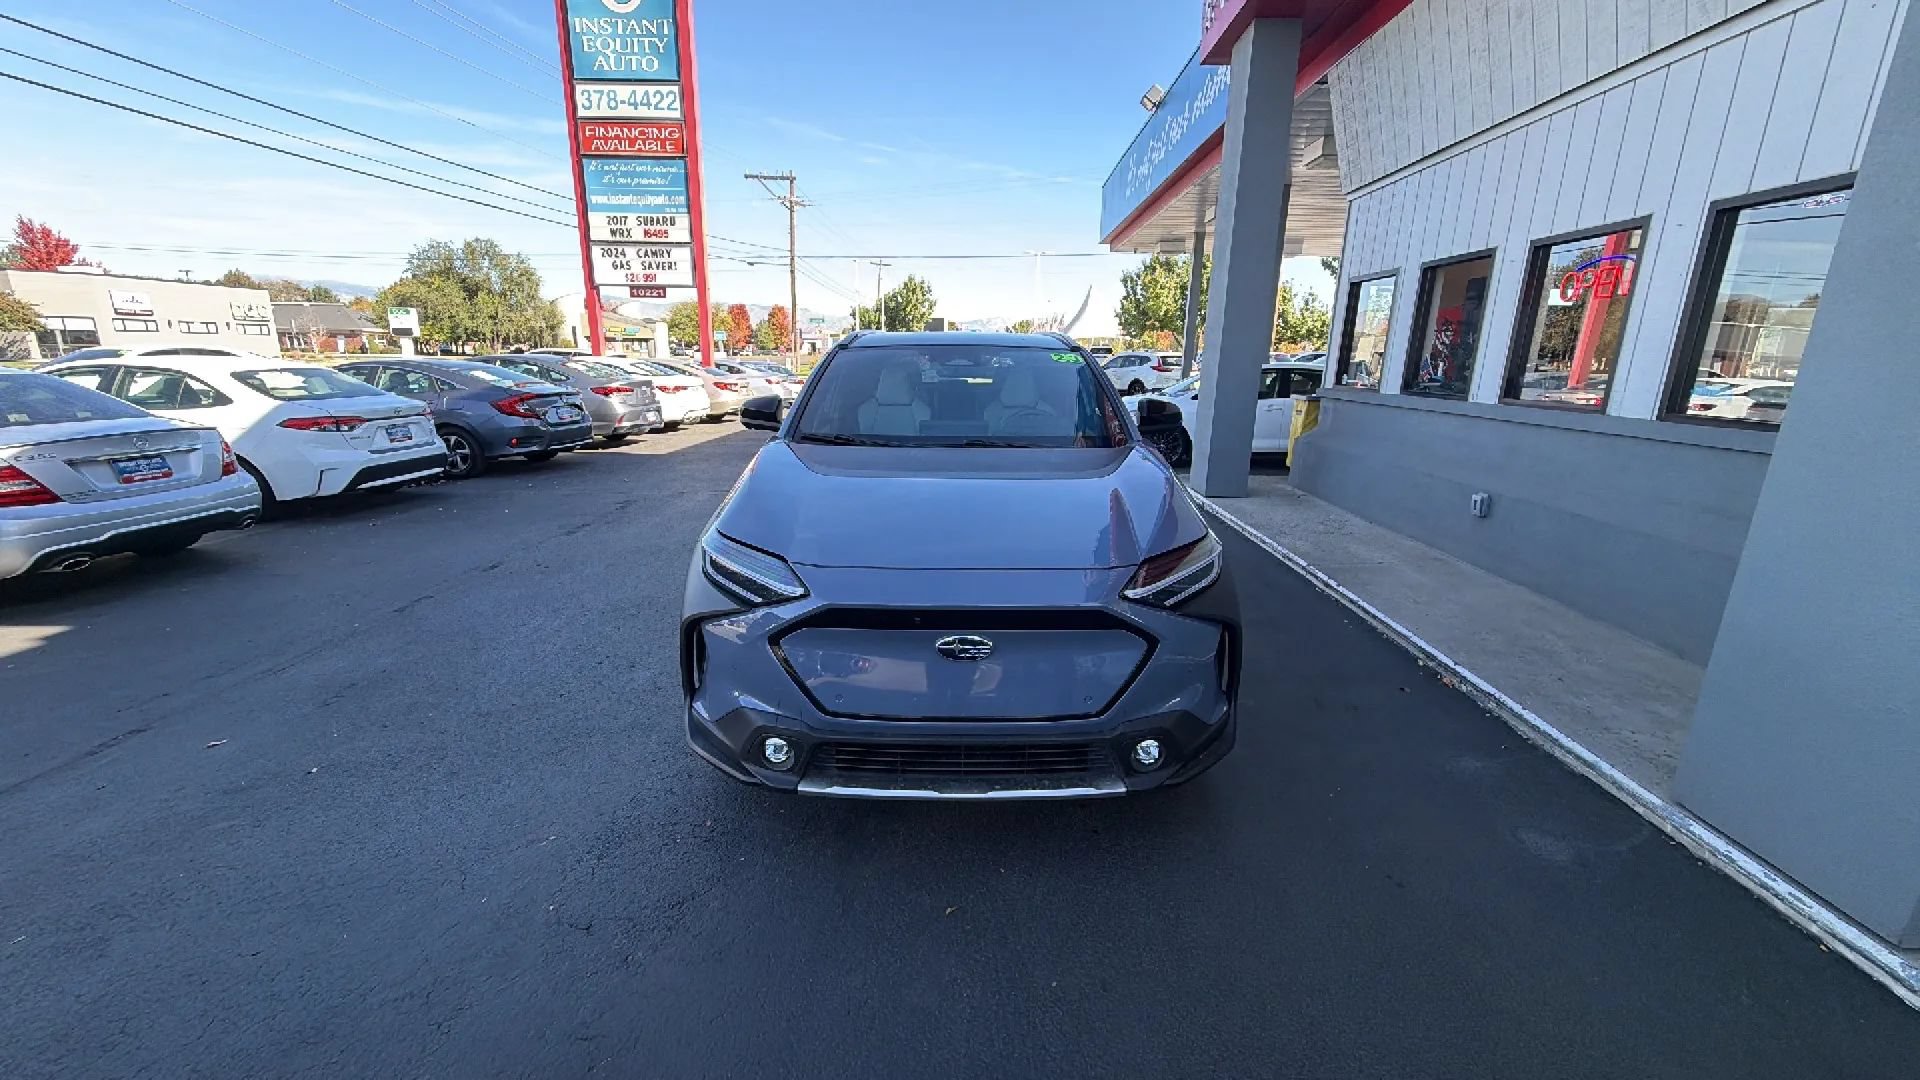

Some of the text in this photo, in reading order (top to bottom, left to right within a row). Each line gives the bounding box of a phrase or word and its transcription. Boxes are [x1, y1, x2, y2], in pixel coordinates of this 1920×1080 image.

[574, 18, 672, 35] INSTANT
[582, 36, 668, 54] EQUITY
[594, 54, 658, 72] AUTO
[581, 89, 678, 111] 378-4422
[585, 126, 680, 138] FINANCING
[592, 139, 677, 152] AVAILABLE
[606, 215, 676, 226] 2017 SUBARU
[609, 228, 632, 239] WRX
[600, 247, 672, 258] 2024 CAMRY
[612, 260, 677, 271] GAS SAVER!
[1560, 259, 1635, 302] OPEN
[631, 288, 665, 297] 10221
